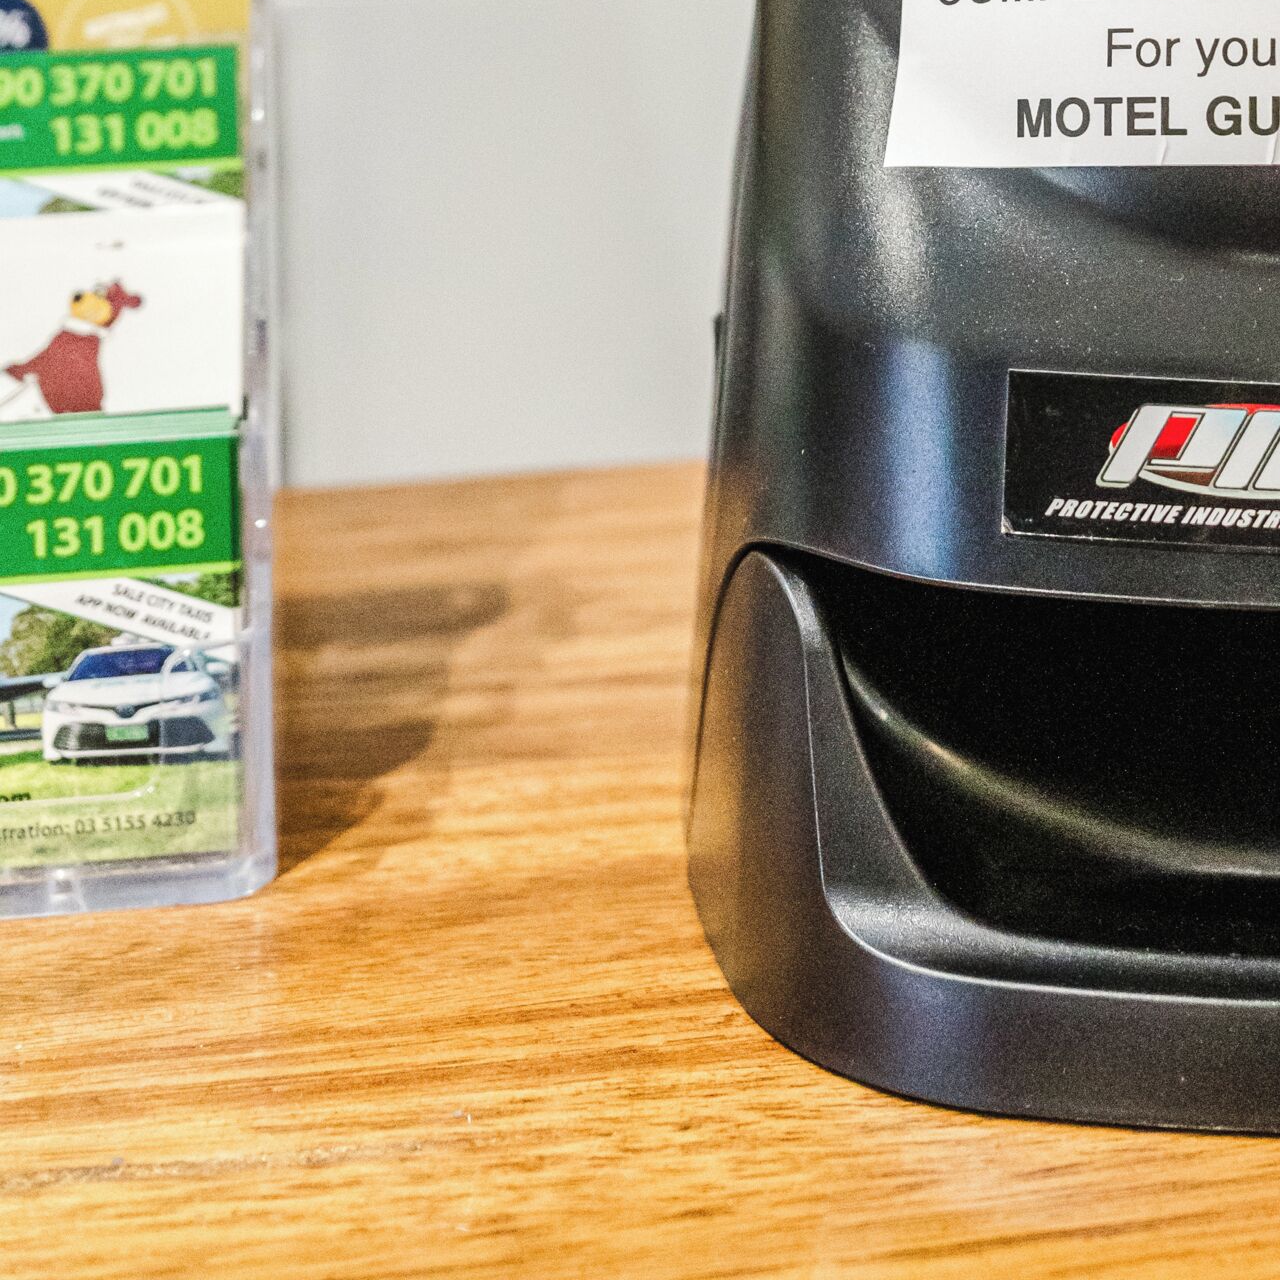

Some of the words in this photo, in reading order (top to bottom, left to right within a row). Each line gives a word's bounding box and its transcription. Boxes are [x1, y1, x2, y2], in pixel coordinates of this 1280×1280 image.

[1106, 27, 1181, 68] For
[51, 61, 135, 106] 370
[138, 56, 218, 100] 701
[51, 111, 126, 156] 131
[135, 105, 219, 152] 008
[1016, 96, 1188, 138] MOTEL
[25, 459, 115, 506] 370
[121, 453, 204, 500] 701
[1044, 498, 1182, 524] PROTECTIVE
[25, 514, 105, 560] 131
[117, 507, 206, 554] 008
[76, 594, 103, 607] APP
[105, 602, 138, 619] NOW
[112, 583, 145, 602] SALE
[146, 593, 176, 612] CITY
[0, 822, 71, 841] tration:
[75, 818, 97, 836] 03
[102, 813, 147, 833] 5155
